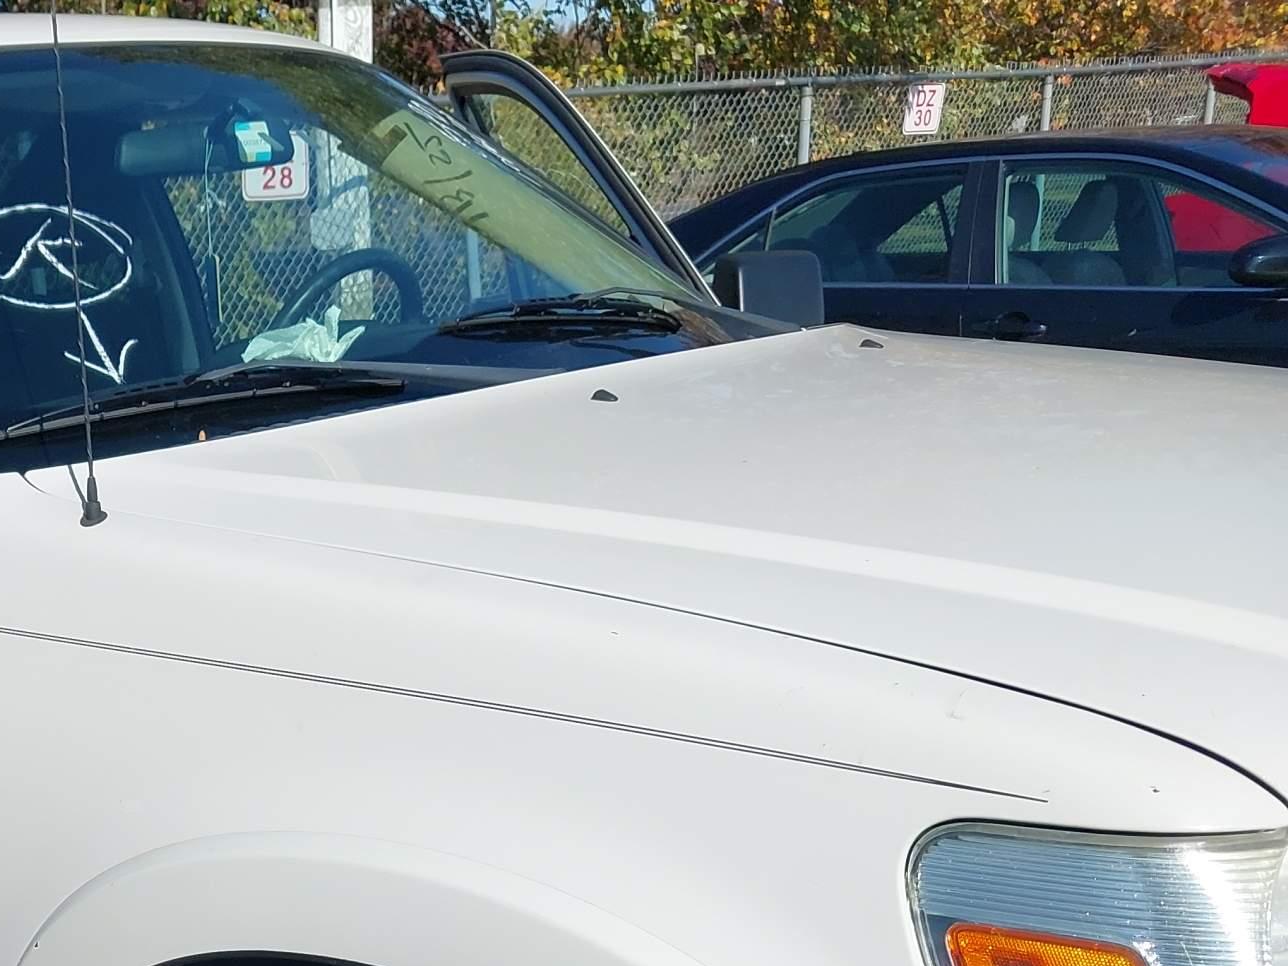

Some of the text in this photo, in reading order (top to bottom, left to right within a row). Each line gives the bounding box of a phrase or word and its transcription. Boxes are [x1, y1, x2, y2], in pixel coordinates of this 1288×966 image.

[916, 90, 937, 107] DZ
[914, 110, 932, 126] 30
[262, 165, 293, 190] 28
